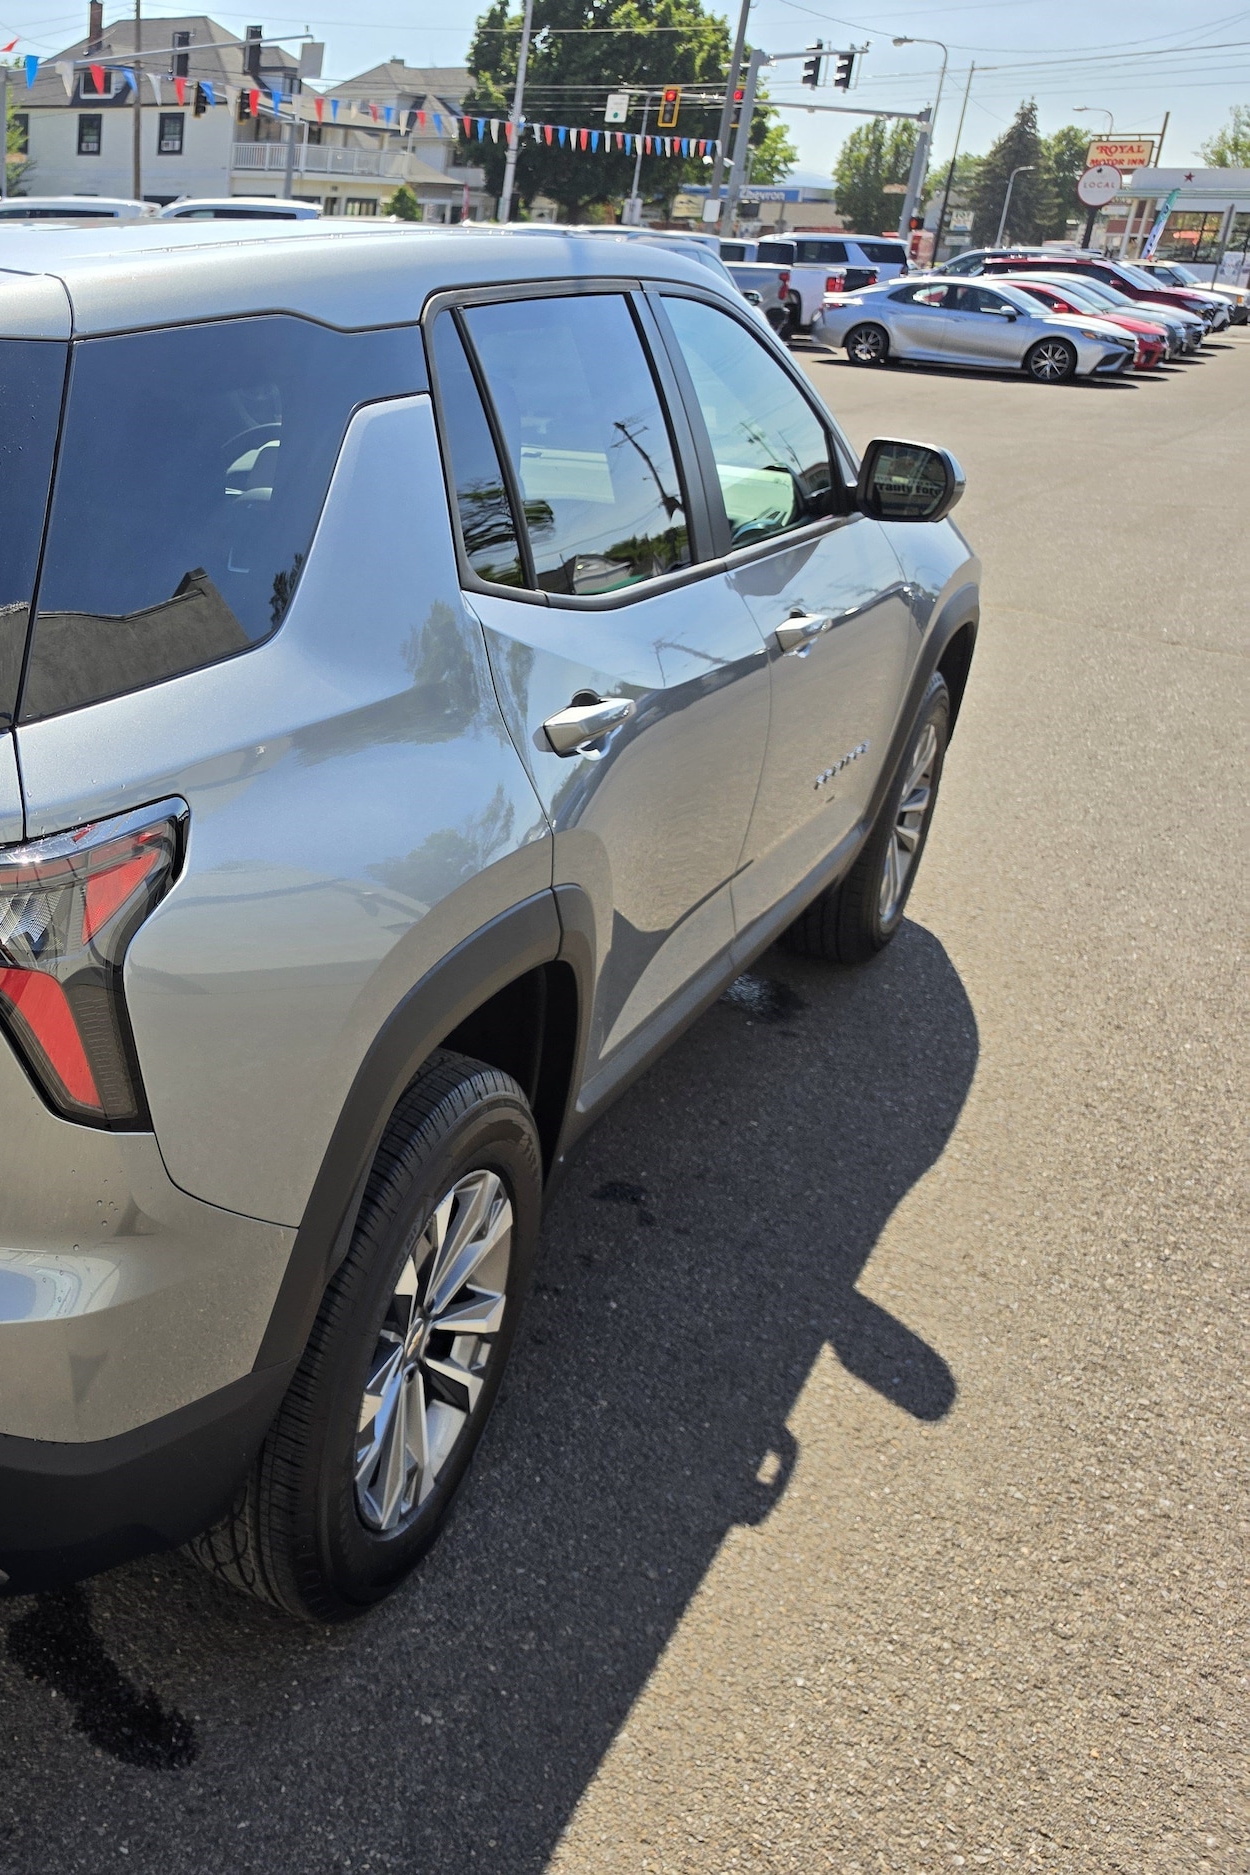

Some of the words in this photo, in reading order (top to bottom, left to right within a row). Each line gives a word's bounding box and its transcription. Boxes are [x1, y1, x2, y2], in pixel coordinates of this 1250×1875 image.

[1096, 144, 1145, 157] ROYAL
[1090, 158, 1125, 167] MOTOR
[1127, 158, 1146, 166] INN
[1083, 181, 1116, 189] LOCAL
[739, 188, 786, 201] Chevron
